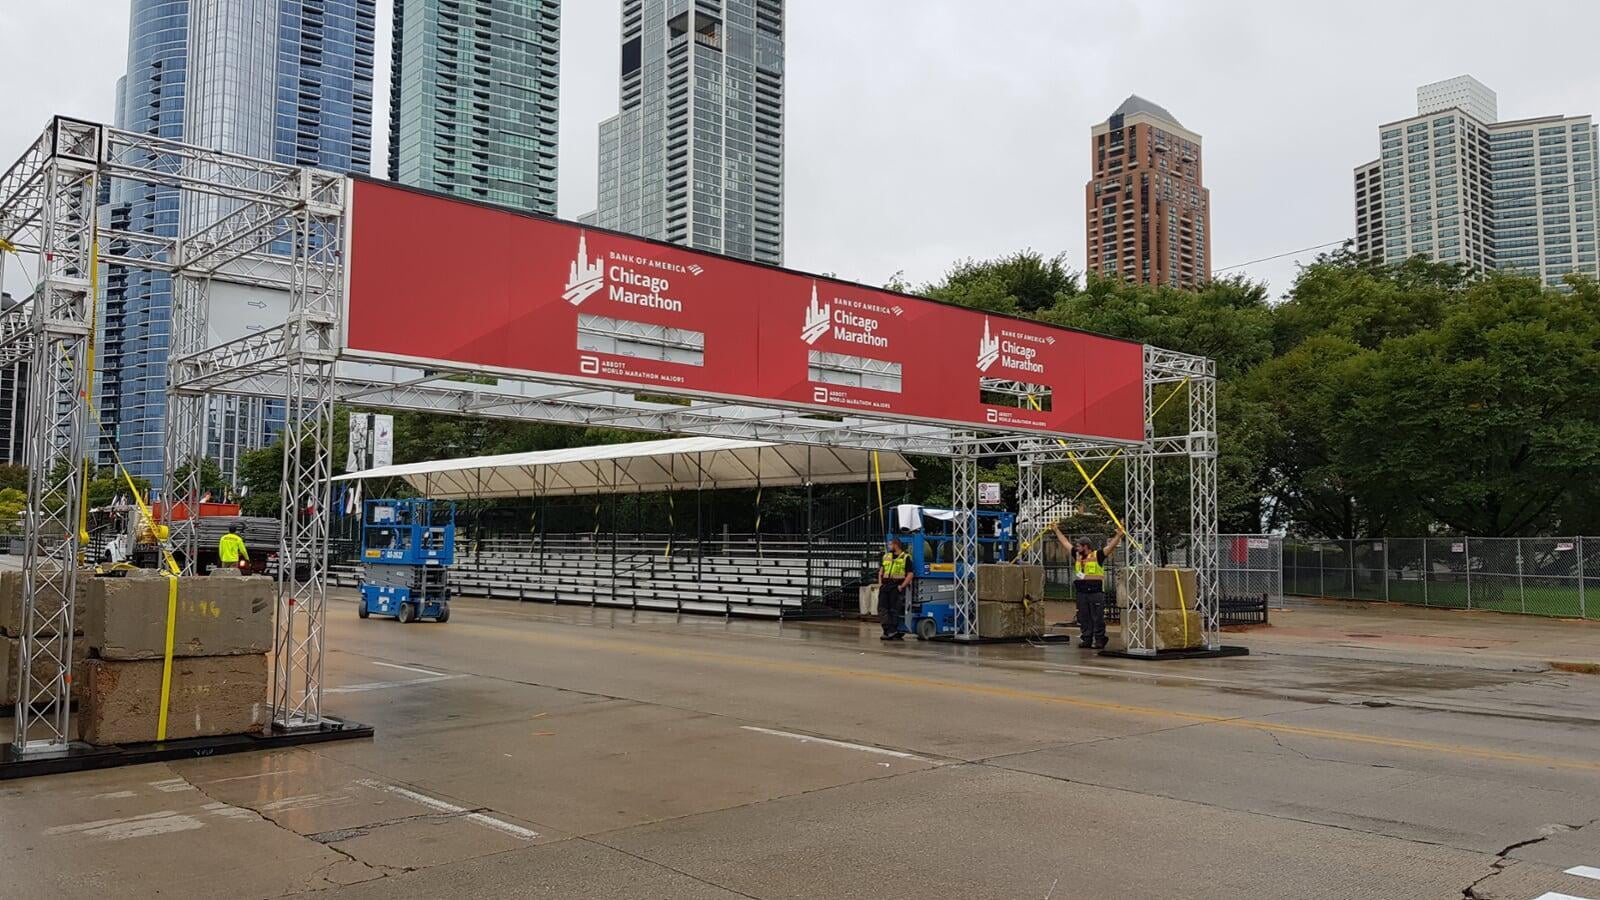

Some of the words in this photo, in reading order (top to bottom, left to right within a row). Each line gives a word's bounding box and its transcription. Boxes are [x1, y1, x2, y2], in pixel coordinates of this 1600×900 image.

[610, 252, 634, 263] BANK
[636, 257, 646, 265] OF
[649, 260, 686, 273] AMERICA
[610, 266, 668, 293] Chicago
[610, 285, 682, 312] Marathon
[834, 298, 852, 306] BANK
[853, 301, 861, 309] OF
[863, 304, 890, 314] AMERICA
[834, 310, 878, 332] Chicago
[834, 327, 888, 347] Marathon
[1024, 335, 1045, 343] AMERICA
[1002, 341, 1036, 359] Chicago
[1002, 356, 1044, 373] Marathon
[602, 368, 623, 376] WORLD
[625, 371, 659, 379] MARATHON
[661, 374, 685, 382] MAJORS
